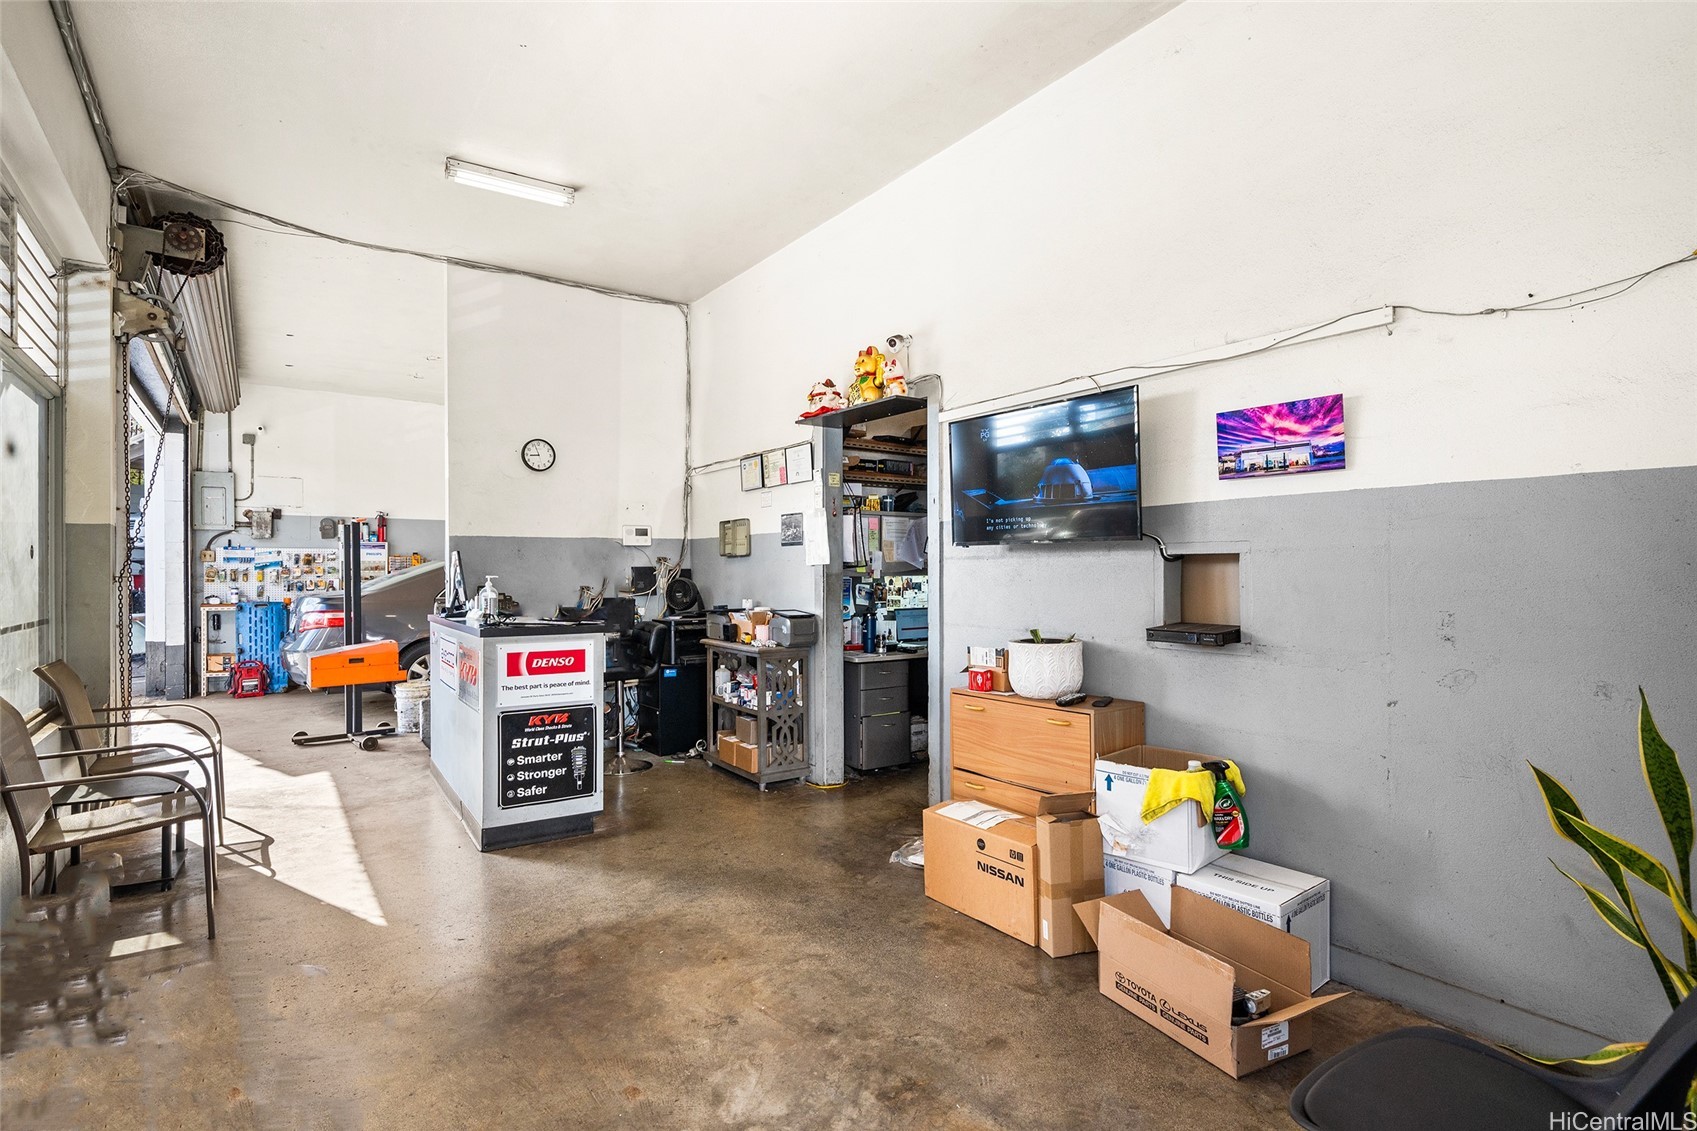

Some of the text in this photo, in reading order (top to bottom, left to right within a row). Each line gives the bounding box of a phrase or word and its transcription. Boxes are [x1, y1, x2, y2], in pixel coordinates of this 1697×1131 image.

[532, 656, 575, 668] DENSO
[528, 713, 569, 726] KYB
[512, 733, 584, 748] Strut-Plus
[516, 753, 563, 765] Smarter
[516, 767, 567, 781] Stronger
[516, 785, 547, 797] Safer
[977, 861, 1024, 887] NISSAN
[1117, 863, 1131, 874] GALLON
[1132, 867, 1147, 880] PLASTIC
[1148, 874, 1164, 885] BOTTLES
[1214, 873, 1233, 881] THIS
[1252, 909, 1273, 923] BOTTLES
[1126, 978, 1207, 1032] TOYOTA LEXUS
[1138, 996, 1156, 1011] PARTS
[1187, 1027, 1207, 1043] PARTS
